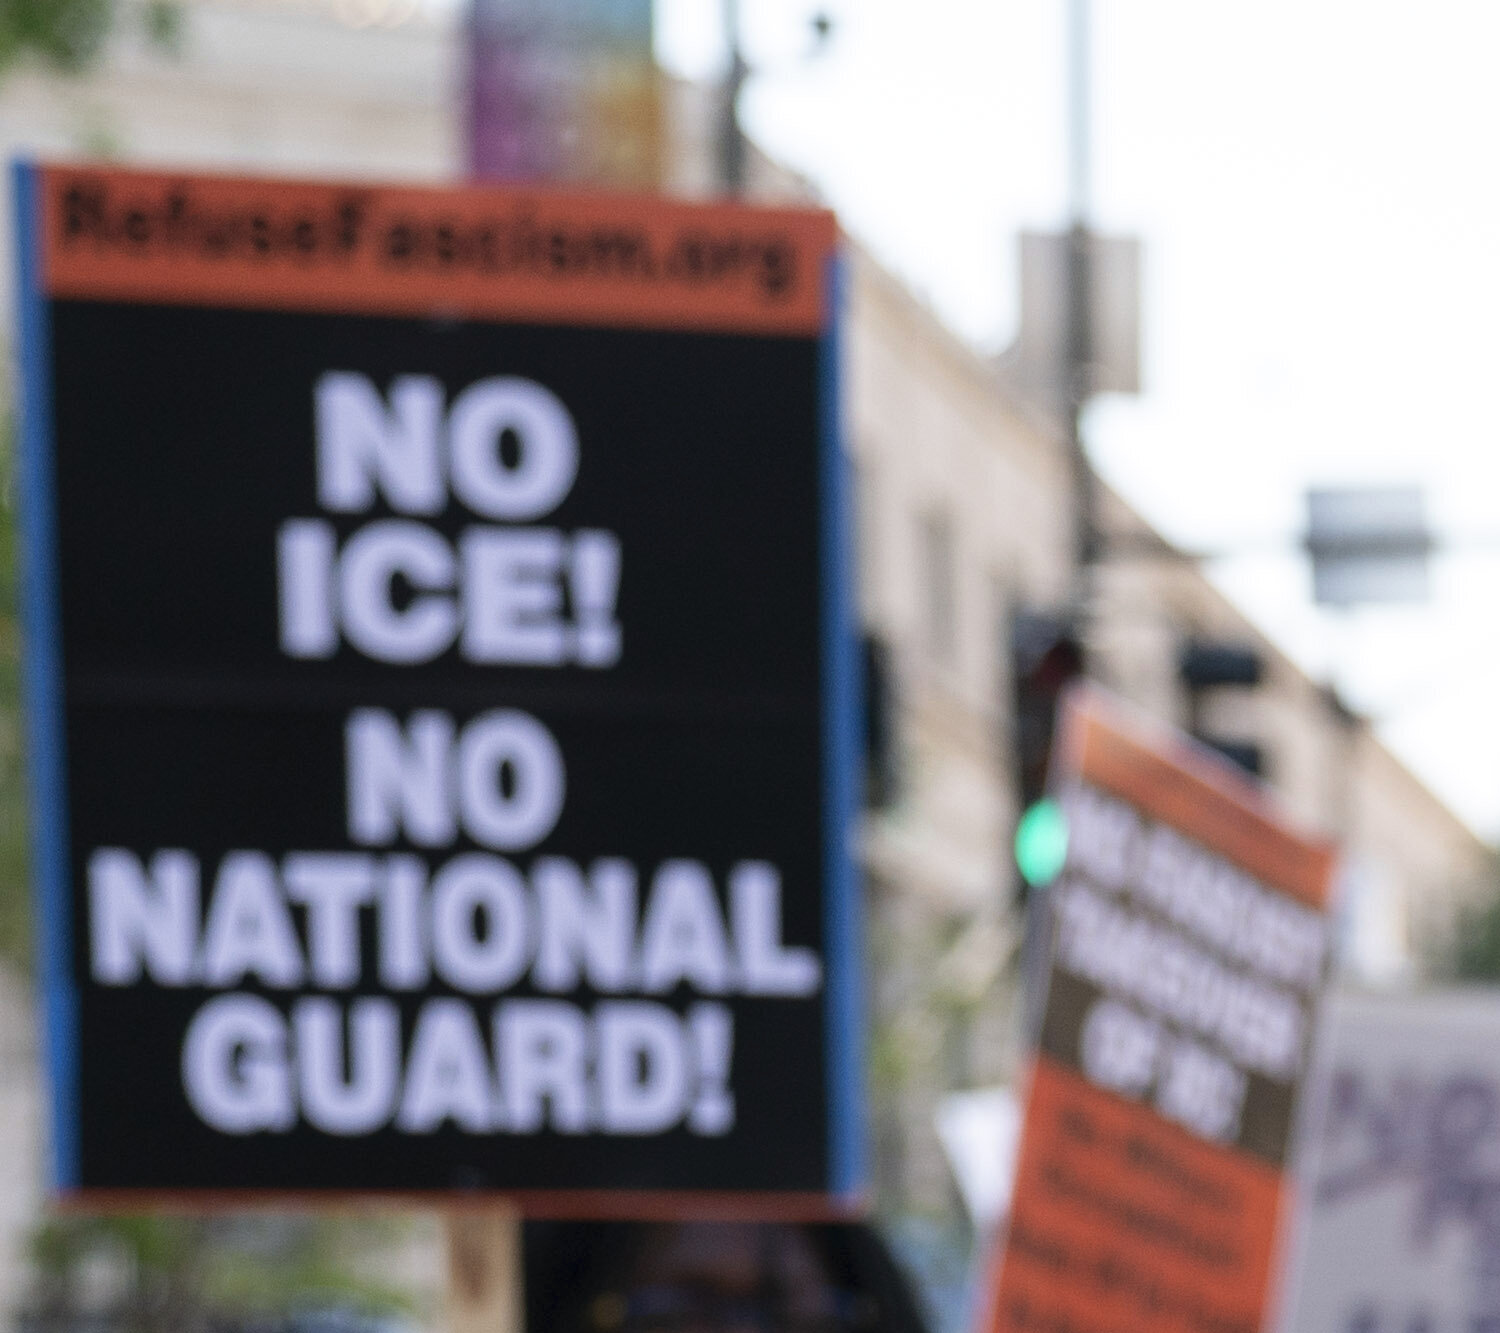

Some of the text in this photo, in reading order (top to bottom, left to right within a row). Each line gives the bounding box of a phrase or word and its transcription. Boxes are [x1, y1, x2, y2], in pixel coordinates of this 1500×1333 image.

[58, 180, 800, 298] RefuseFascism.org
[314, 370, 582, 522] NO
[277, 520, 622, 668] ICE!
[346, 706, 566, 850] NO
[88, 846, 822, 998] NATIONAL
[180, 994, 735, 1135] GUARD!
